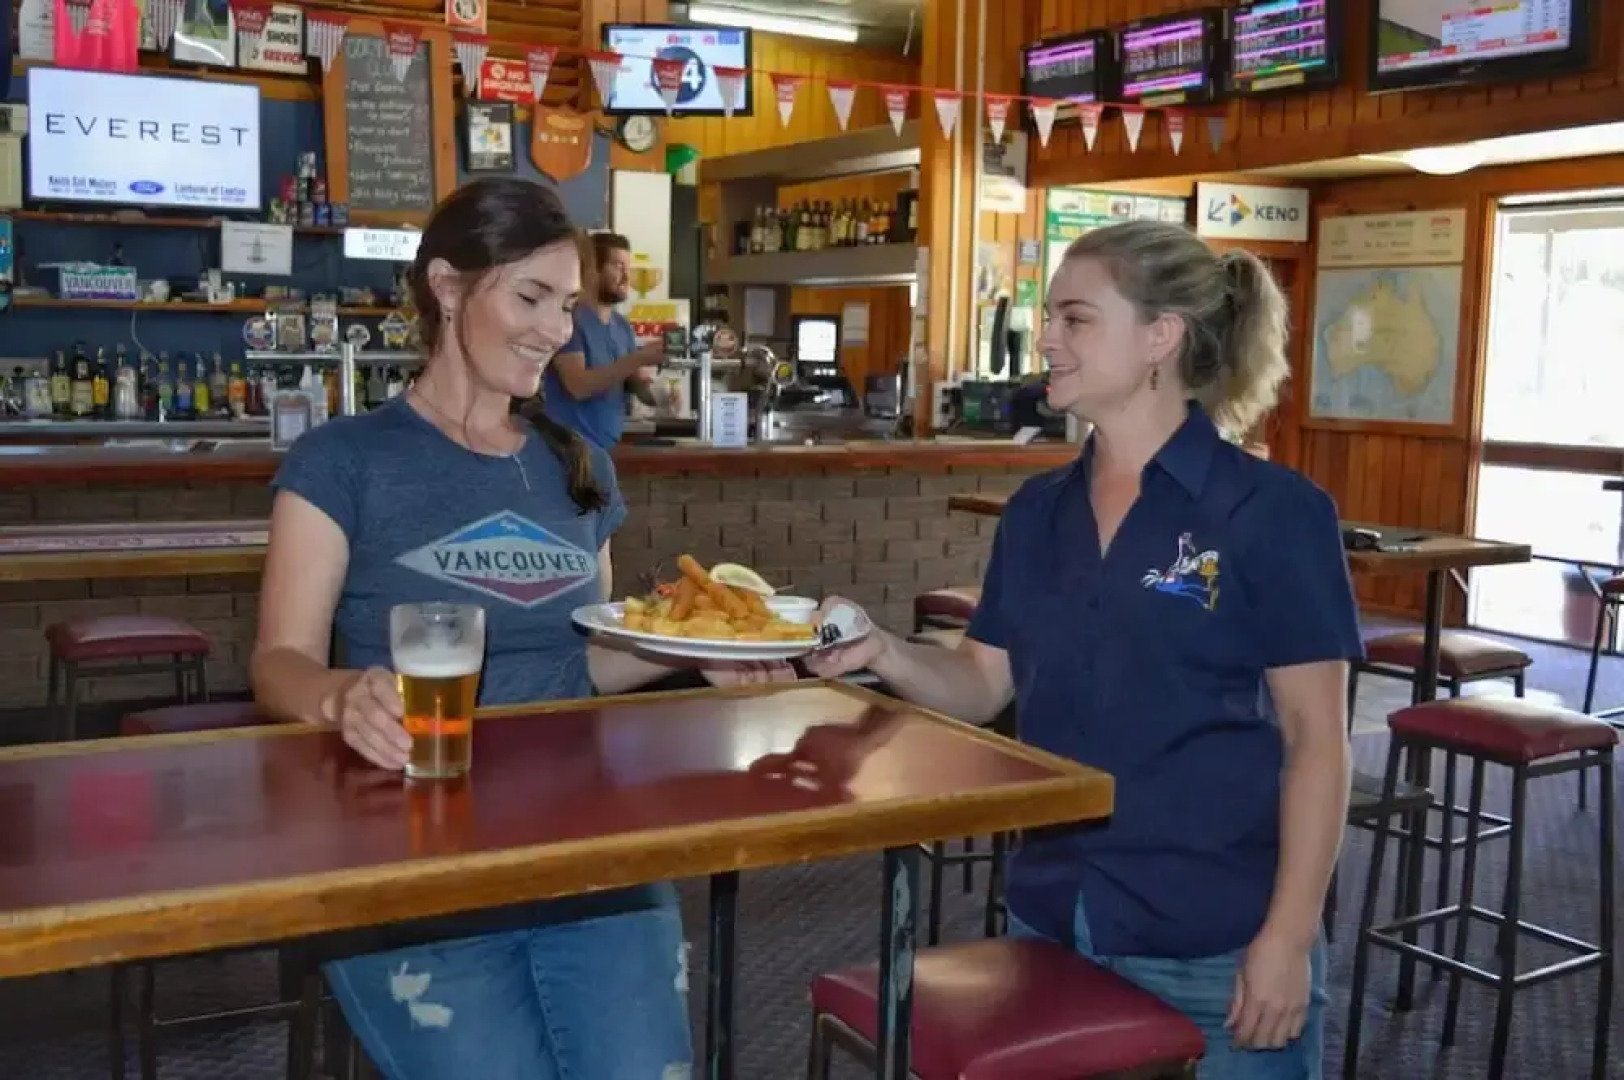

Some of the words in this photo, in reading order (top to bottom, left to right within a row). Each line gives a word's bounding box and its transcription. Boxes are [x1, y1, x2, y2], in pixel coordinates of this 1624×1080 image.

[266, 30, 298, 45] SHOES
[45, 112, 250, 147] EVEREST
[1255, 203, 1300, 221] KENO
[433, 550, 590, 574] VANCOUVER
